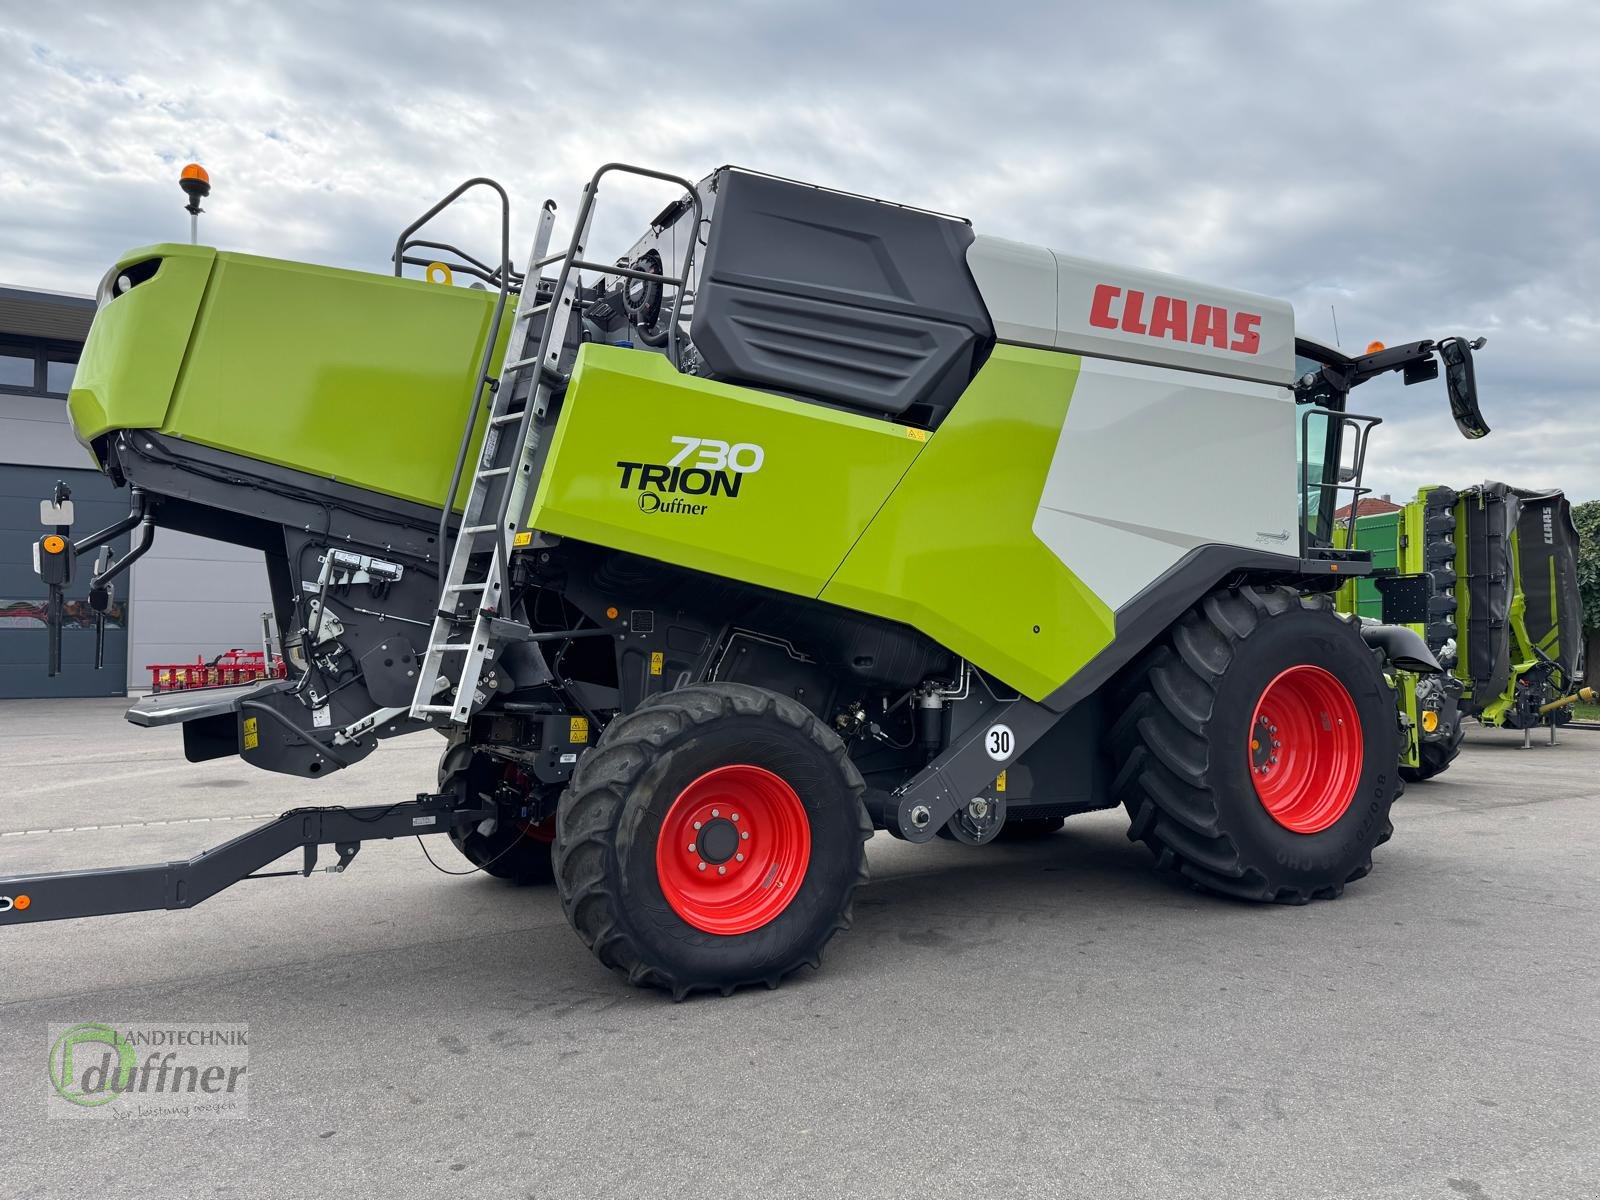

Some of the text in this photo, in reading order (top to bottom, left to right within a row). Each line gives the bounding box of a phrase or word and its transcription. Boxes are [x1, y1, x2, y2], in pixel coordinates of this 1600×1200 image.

[1089, 283, 1261, 355] CLAAS
[667, 435, 765, 473] 730
[616, 461, 743, 498] TRION
[638, 491, 708, 515] Duffner
[1542, 506, 1553, 544] CLAAS
[990, 731, 1009, 753] 30
